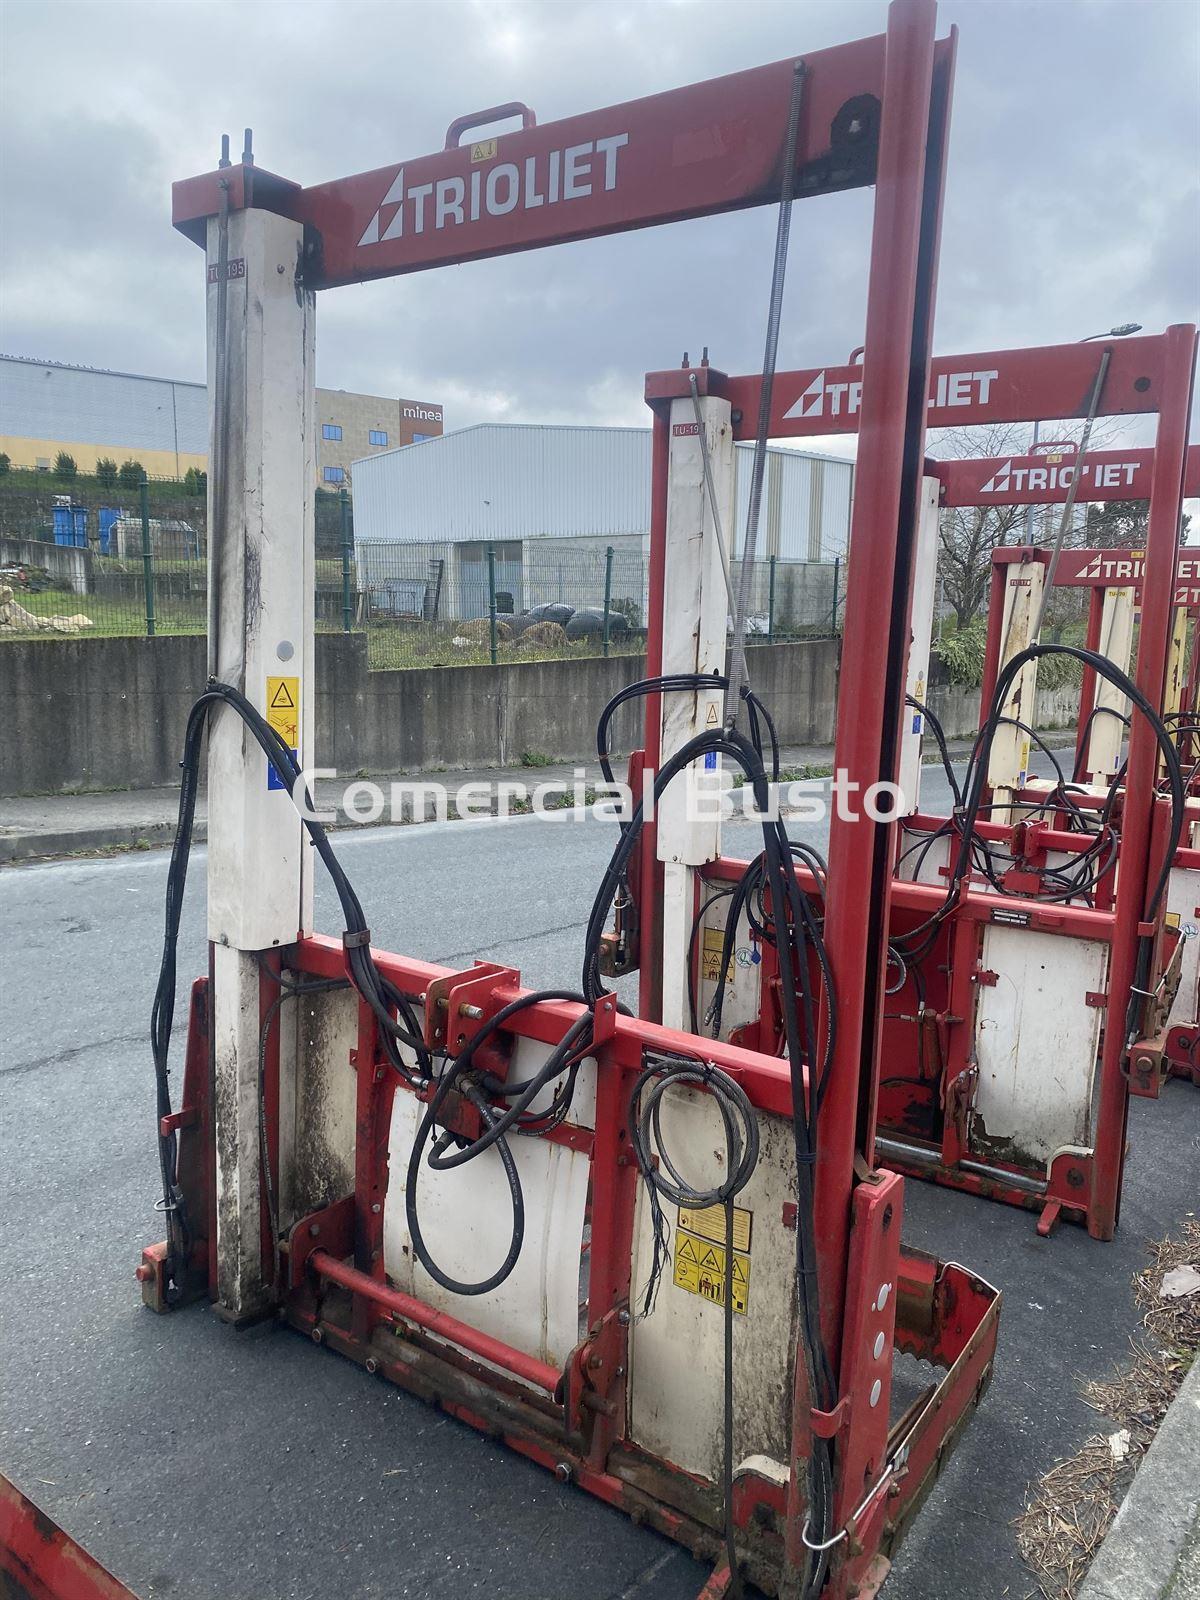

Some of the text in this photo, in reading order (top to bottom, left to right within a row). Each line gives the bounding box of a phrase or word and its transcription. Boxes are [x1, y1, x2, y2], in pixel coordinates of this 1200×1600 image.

[408, 132, 629, 234] TRIOLIET
[403, 405, 442, 421] minea
[673, 425, 702, 434] TU-19
